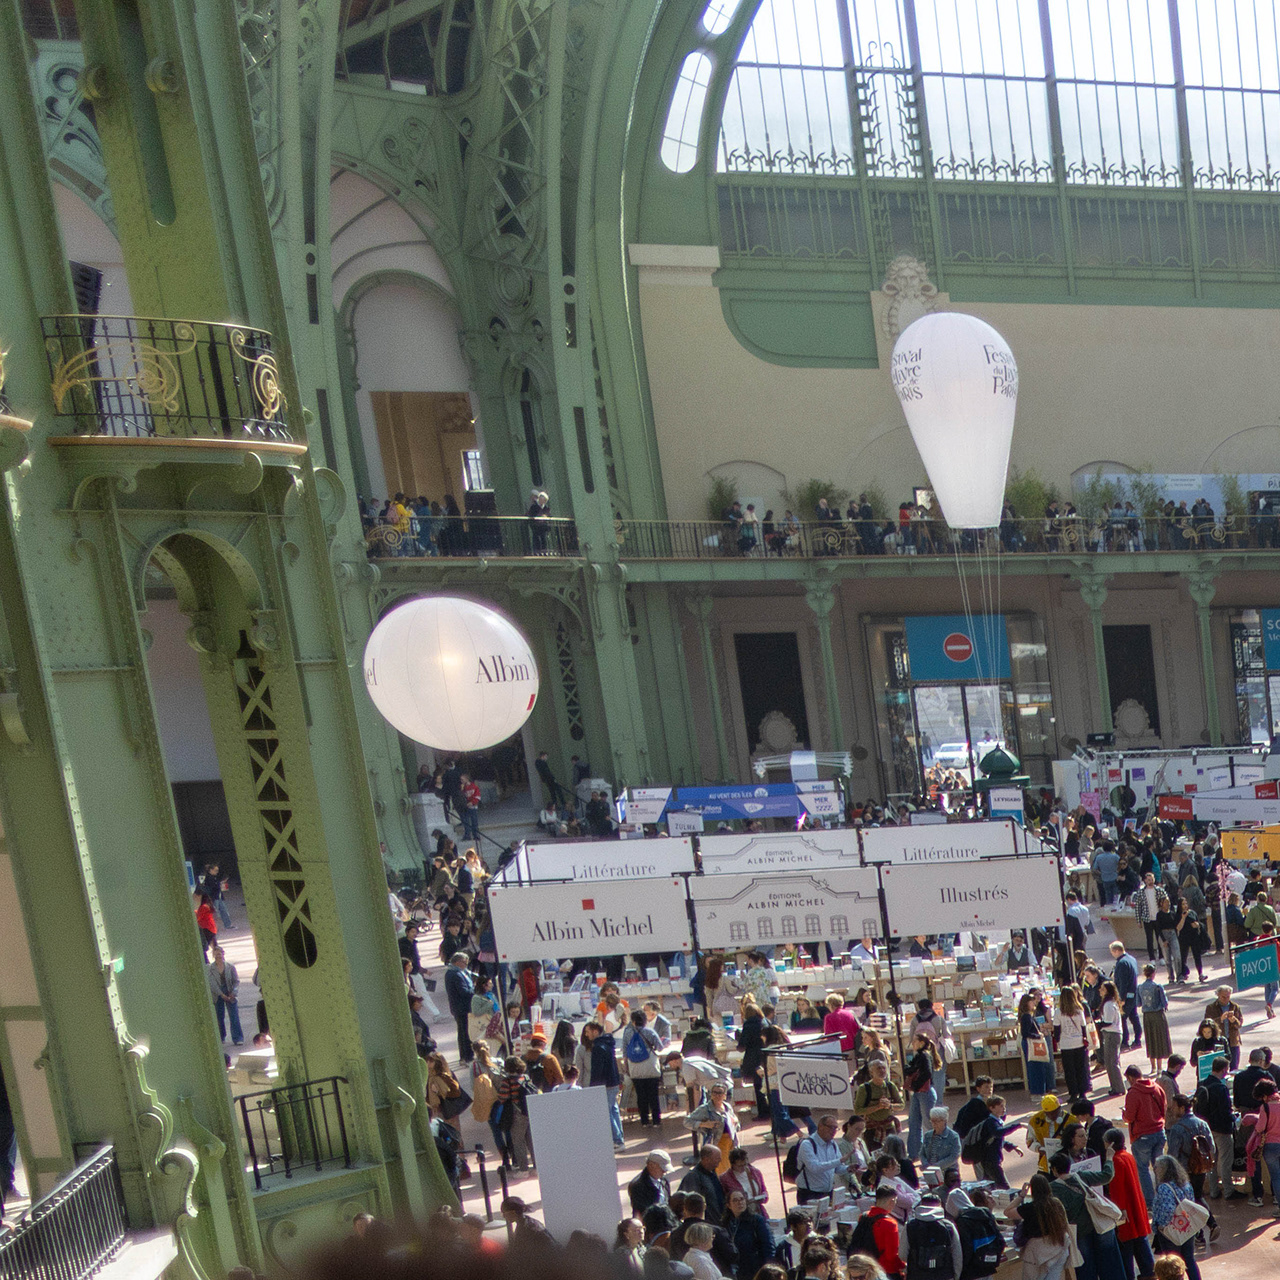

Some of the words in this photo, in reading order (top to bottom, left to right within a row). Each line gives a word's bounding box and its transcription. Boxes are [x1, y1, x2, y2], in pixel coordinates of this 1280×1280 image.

[476, 654, 530, 684] Albin
[675, 822, 696, 831] ZULMA
[746, 856, 777, 865] ALBIN
[779, 854, 813, 864] MICHEL
[764, 849, 793, 857] ÉDITIONS
[902, 846, 979, 862] Littérature
[571, 861, 656, 879] Littérature
[768, 891, 801, 900] ÉDITIONS
[939, 884, 1009, 904] Illustrés
[746, 900, 779, 910] ALBIN
[784, 898, 825, 909] MICHEL
[531, 920, 584, 943] Albin
[590, 915, 654, 939] Michel
[1241, 956, 1272, 978] PAYOT
[799, 1071, 829, 1086] Michel
[795, 1080, 833, 1097] LAFON
